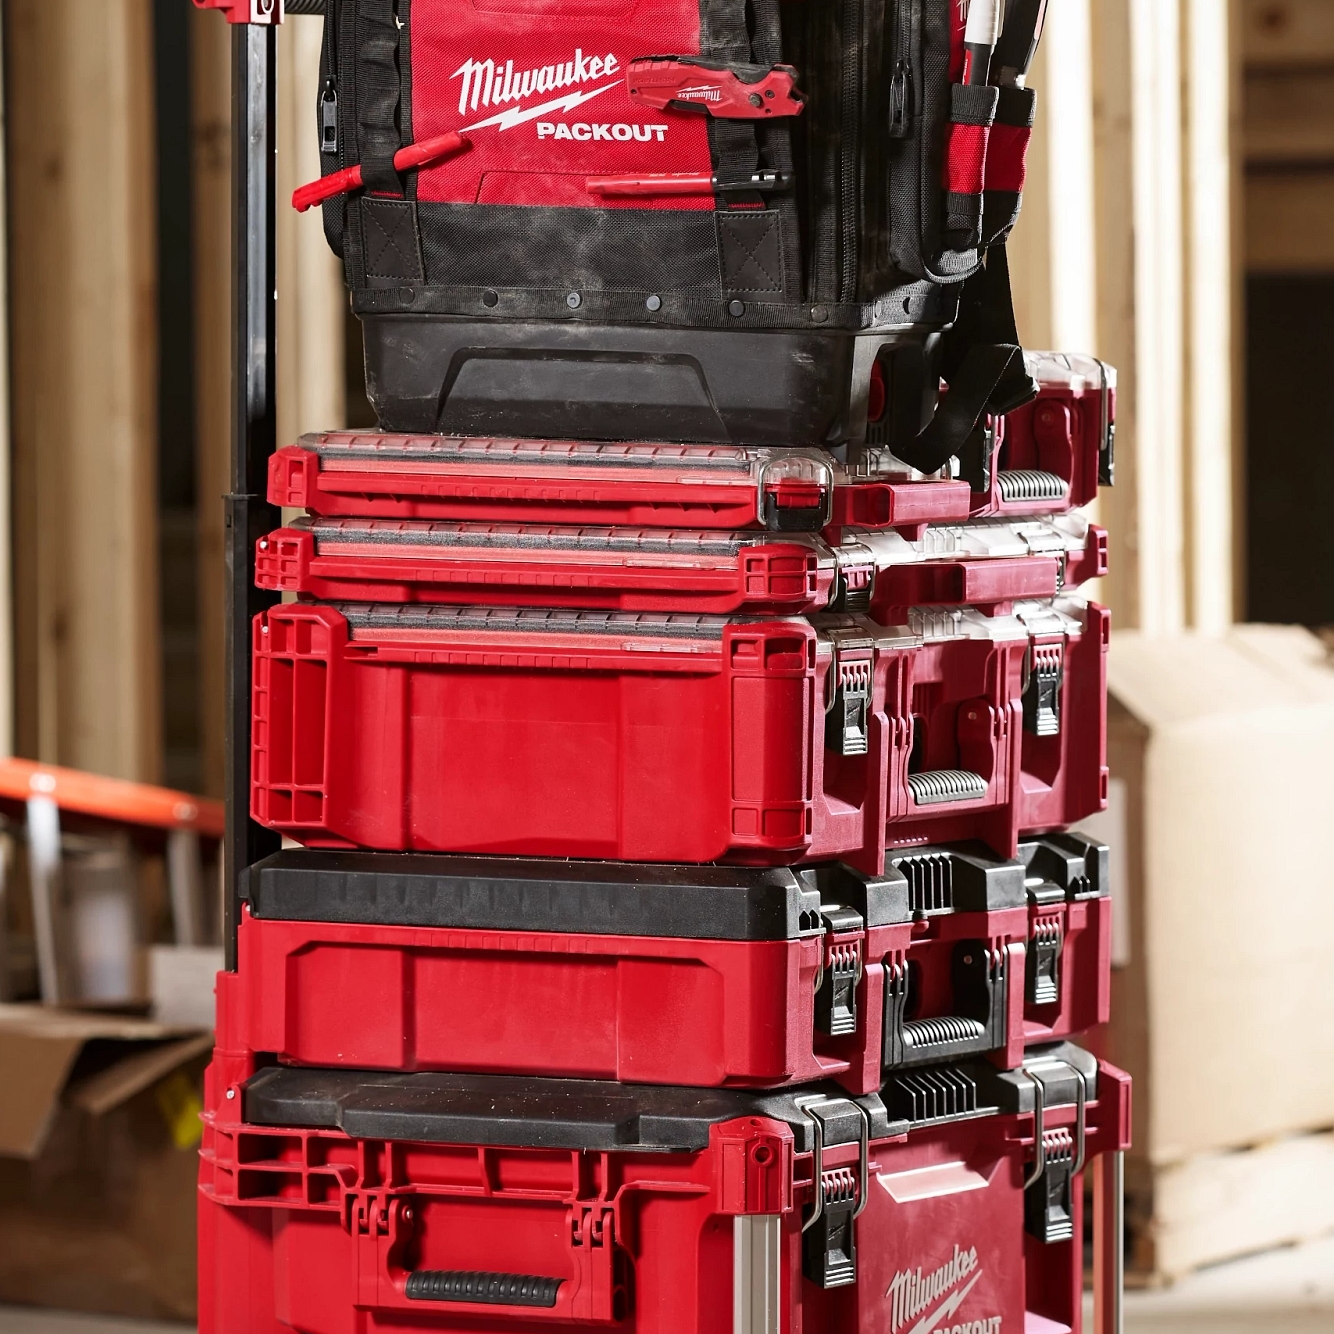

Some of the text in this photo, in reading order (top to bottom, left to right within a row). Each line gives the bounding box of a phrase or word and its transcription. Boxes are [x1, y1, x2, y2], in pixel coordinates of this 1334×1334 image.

[448, 48, 621, 116] Milwaukee
[677, 90, 723, 102] Milwaukee
[536, 122, 669, 142] PACKOUT
